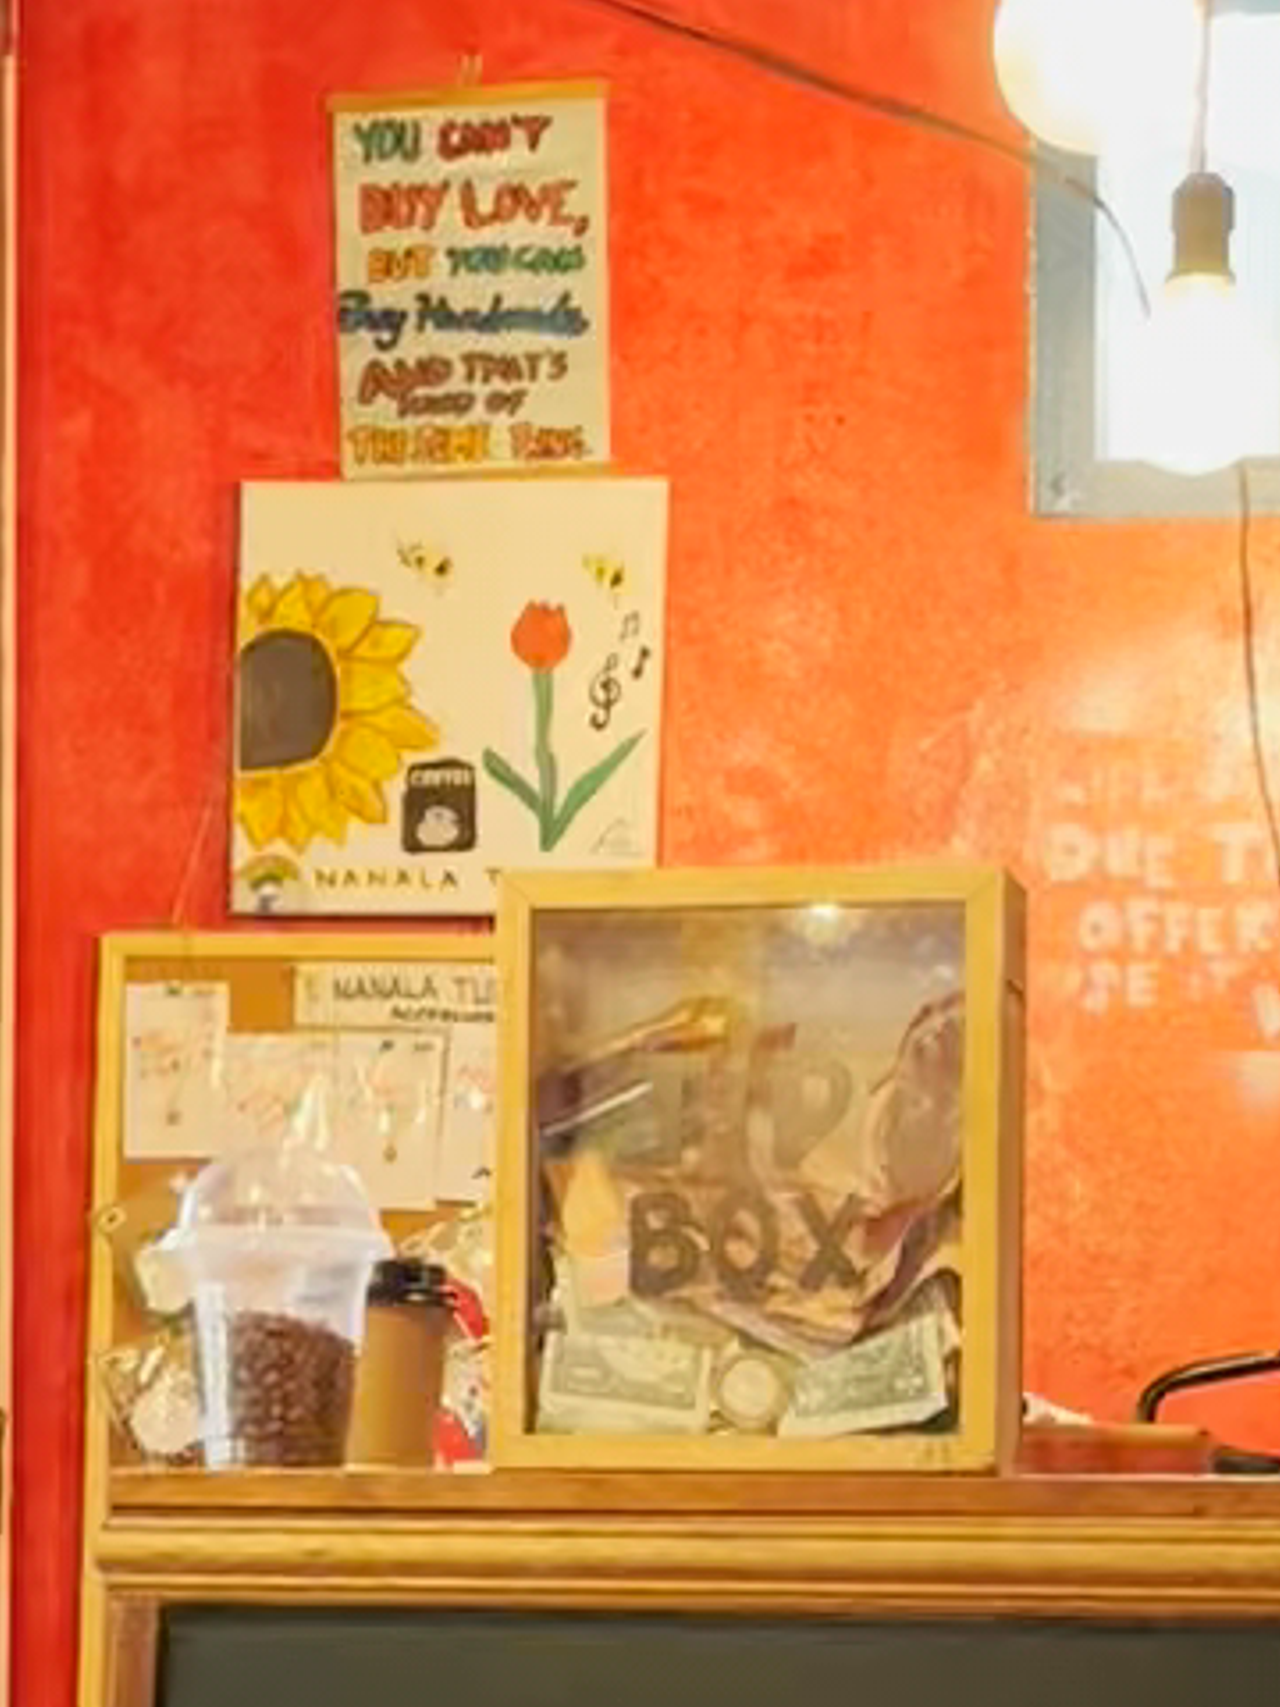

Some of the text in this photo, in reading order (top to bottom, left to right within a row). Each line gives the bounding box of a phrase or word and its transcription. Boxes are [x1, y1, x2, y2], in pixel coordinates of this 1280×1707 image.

[353, 118, 421, 163] YOU
[359, 181, 451, 234] BUY
[628, 1189, 866, 1303] BOX
